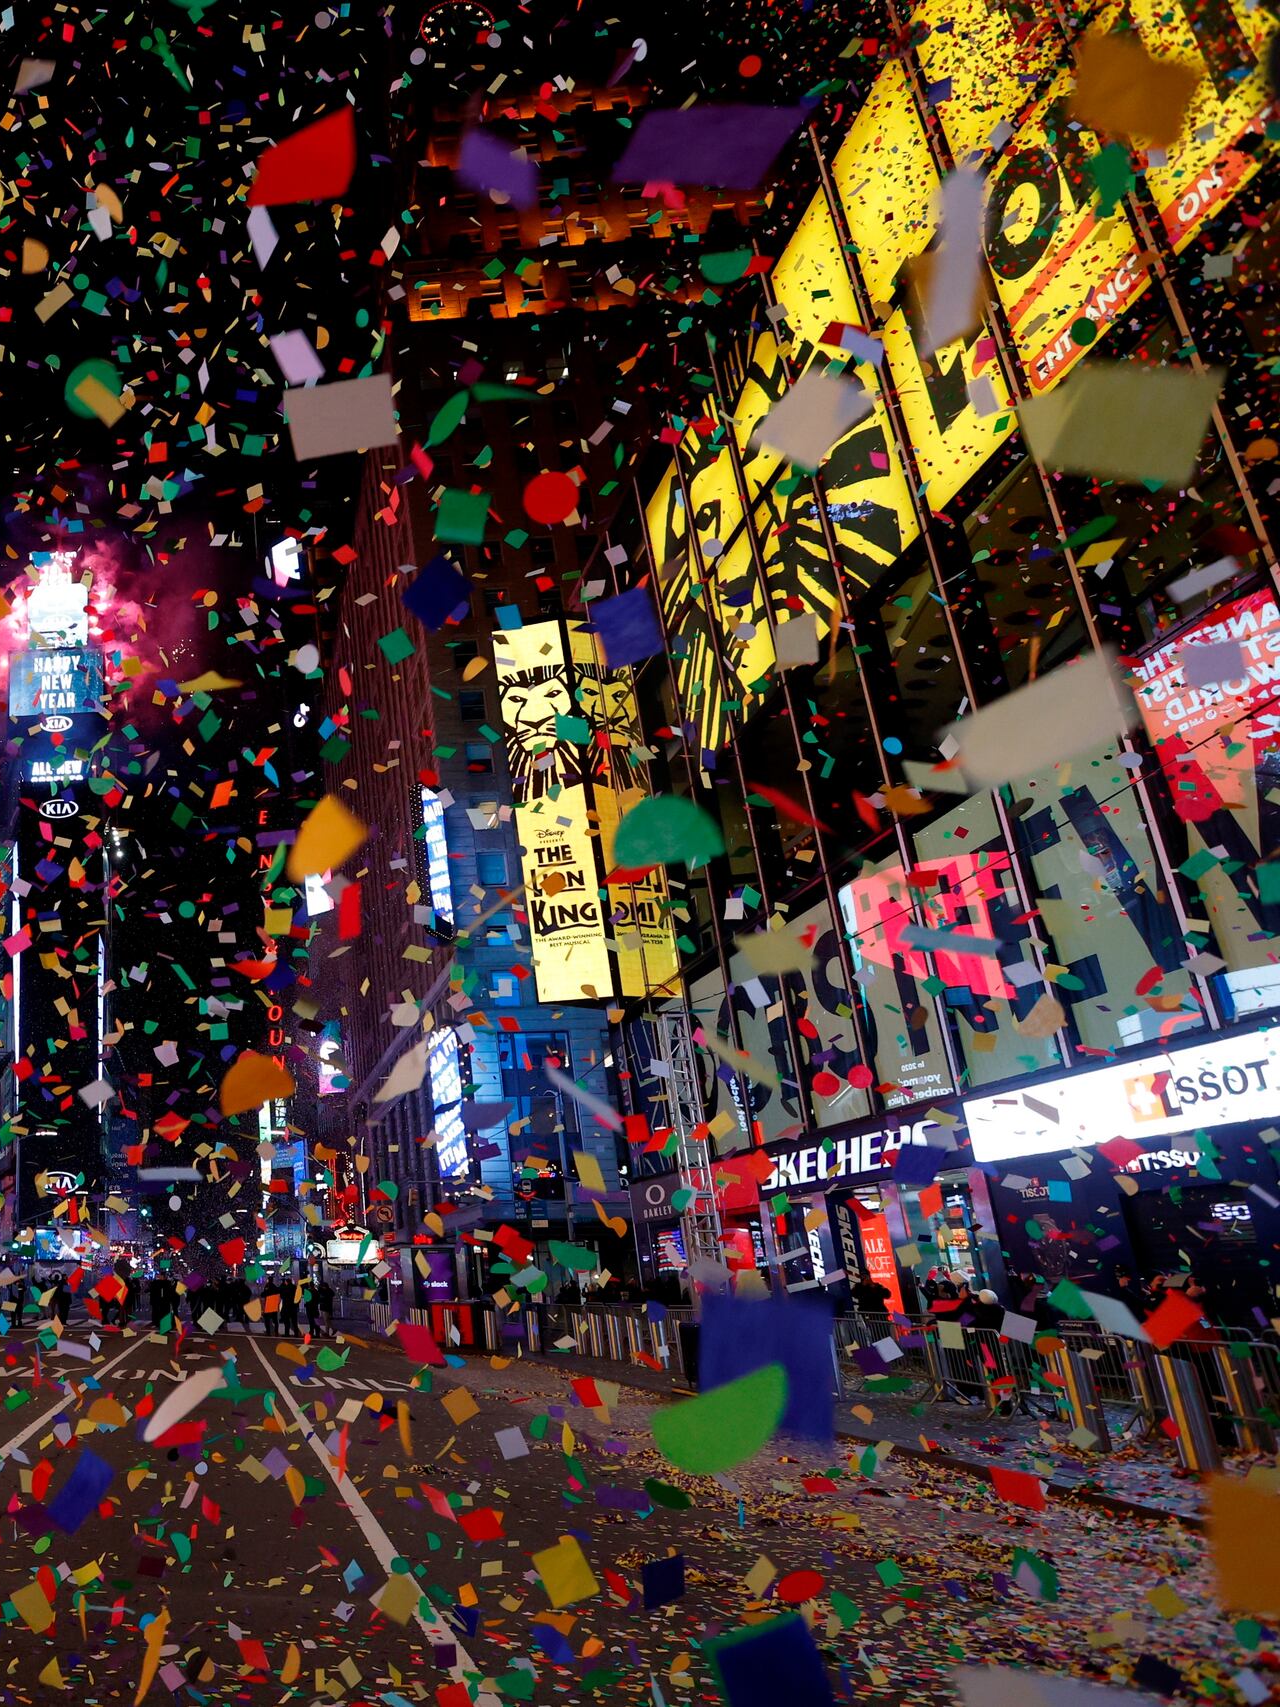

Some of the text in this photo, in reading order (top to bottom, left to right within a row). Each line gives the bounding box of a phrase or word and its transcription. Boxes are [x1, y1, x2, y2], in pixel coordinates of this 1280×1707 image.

[1035, 253, 1143, 381] ENTANC
[33, 655, 80, 673] HAPPY
[40, 674, 72, 690] NEW
[39, 691, 76, 709] YEAR
[43, 801, 75, 816] KIA
[534, 845, 573, 864] THE
[530, 900, 598, 937] KING
[1137, 1149, 1205, 1171] TISSO
[643, 1205, 673, 1219] OAKLEY
[864, 1238, 886, 1253] ALE
